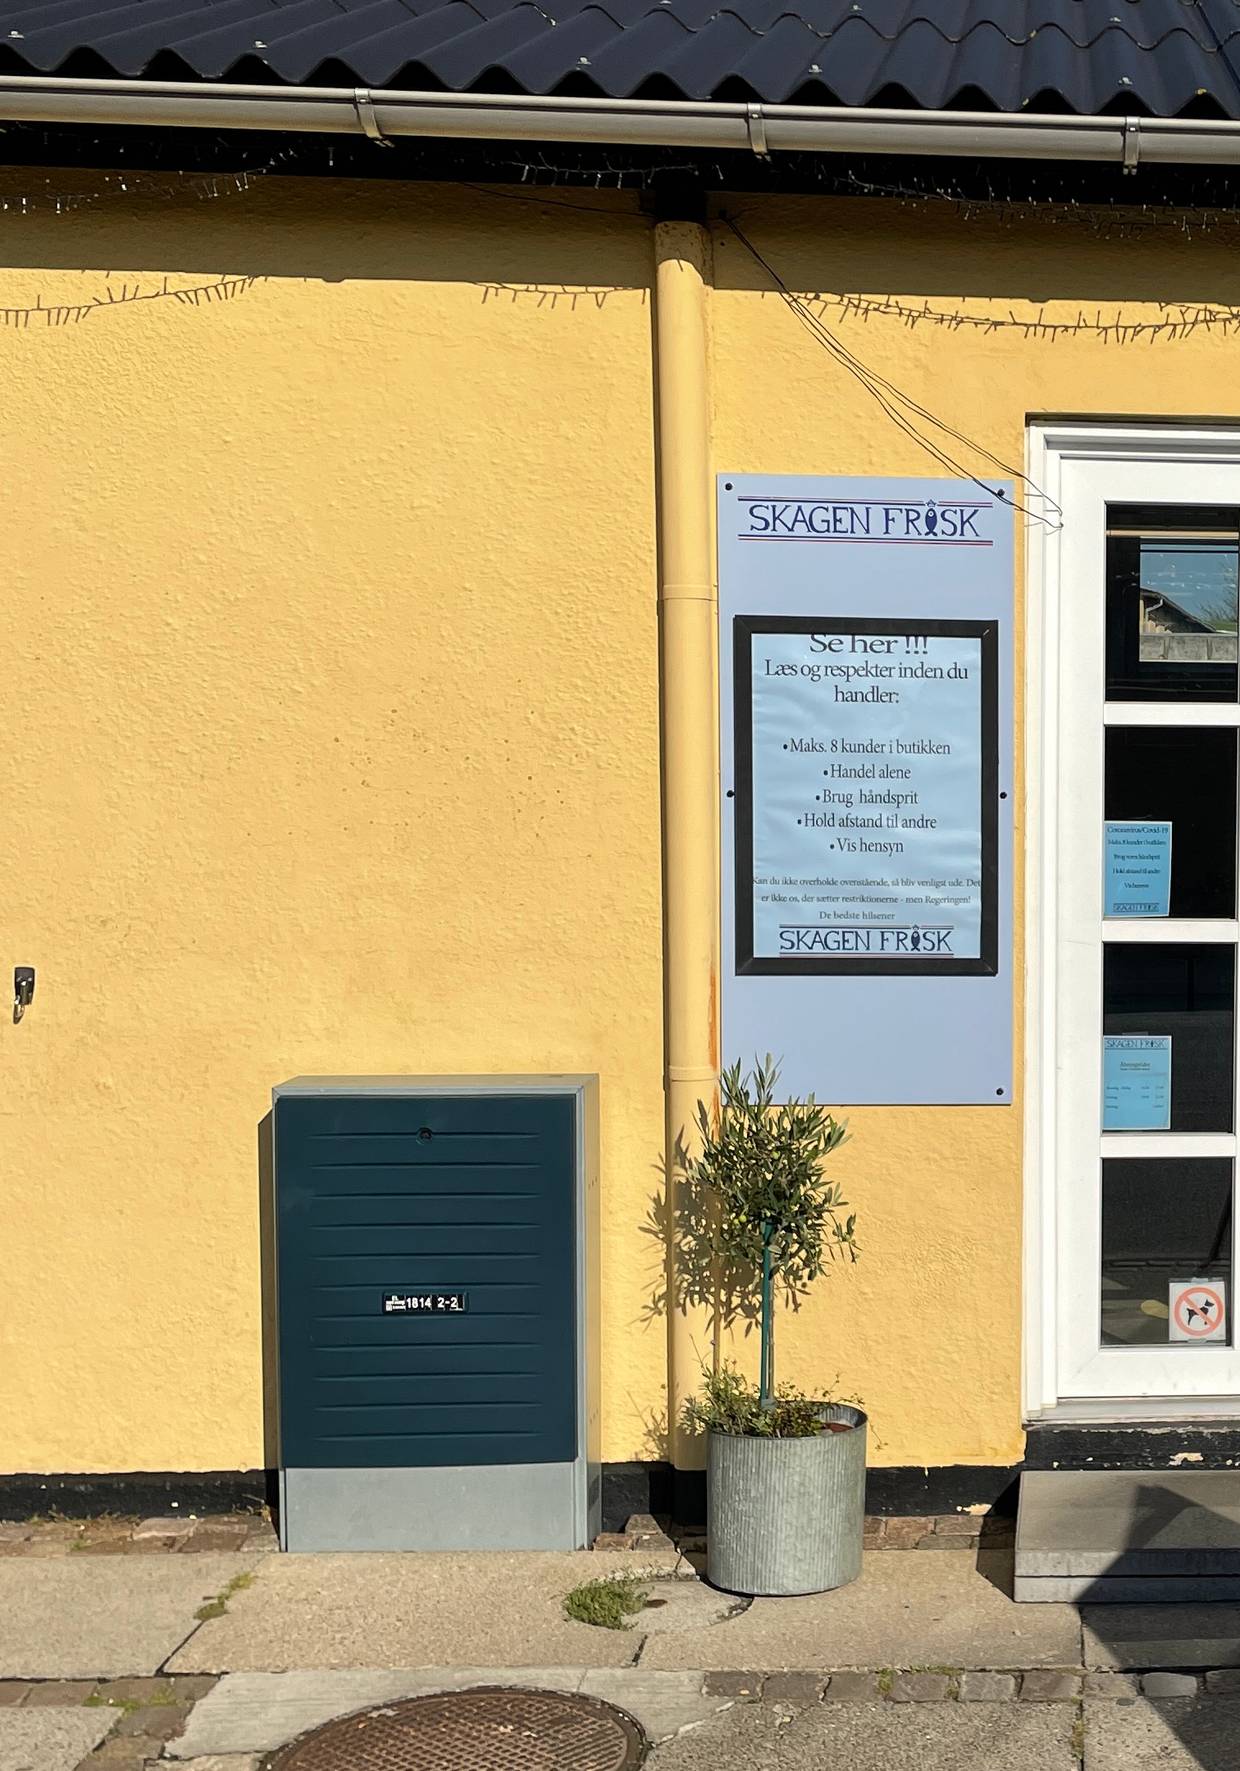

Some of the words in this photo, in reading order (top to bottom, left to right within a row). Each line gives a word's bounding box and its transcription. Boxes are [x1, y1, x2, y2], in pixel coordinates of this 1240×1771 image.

[749, 504, 871, 534] SKAGEN
[810, 634, 844, 653] Se
[849, 634, 898, 654] her
[765, 659, 798, 676] Læs
[800, 664, 821, 682] og
[824, 660, 896, 682] respekter
[898, 661, 944, 679] inden
[947, 661, 968, 679] du
[834, 685, 899, 703] handler:
[830, 739, 838, 753] 8
[841, 738, 886, 754] kunder
[888, 739, 894, 754] i
[895, 739, 951, 755] butikken
[830, 764, 875, 779] Handel
[878, 764, 911, 780] alene
[822, 789, 853, 808] Brug
[859, 789, 918, 808] håndsprit
[804, 813, 835, 828] Hold
[838, 813, 883, 829] afstand
[886, 814, 898, 829] til
[901, 814, 937, 829] andre
[837, 838, 857, 852] Vis
[859, 838, 904, 856] hensyn
[769, 877, 780, 885] du
[781, 877, 798, 886] ikke
[800, 877, 839, 886] overholde
[901, 878, 916, 887] bliv
[917, 878, 947, 889] venligst
[771, 894, 788, 902] ikke
[801, 894, 815, 903] der
[816, 895, 840, 903] sætter
[841, 894, 898, 904] restriktionerne
[819, 911, 833, 919] De
[833, 911, 860, 920] bedste
[862, 911, 896, 920] hilsener
[779, 930, 870, 951] SKAGEN
[406, 1297, 432, 1309] 1814
